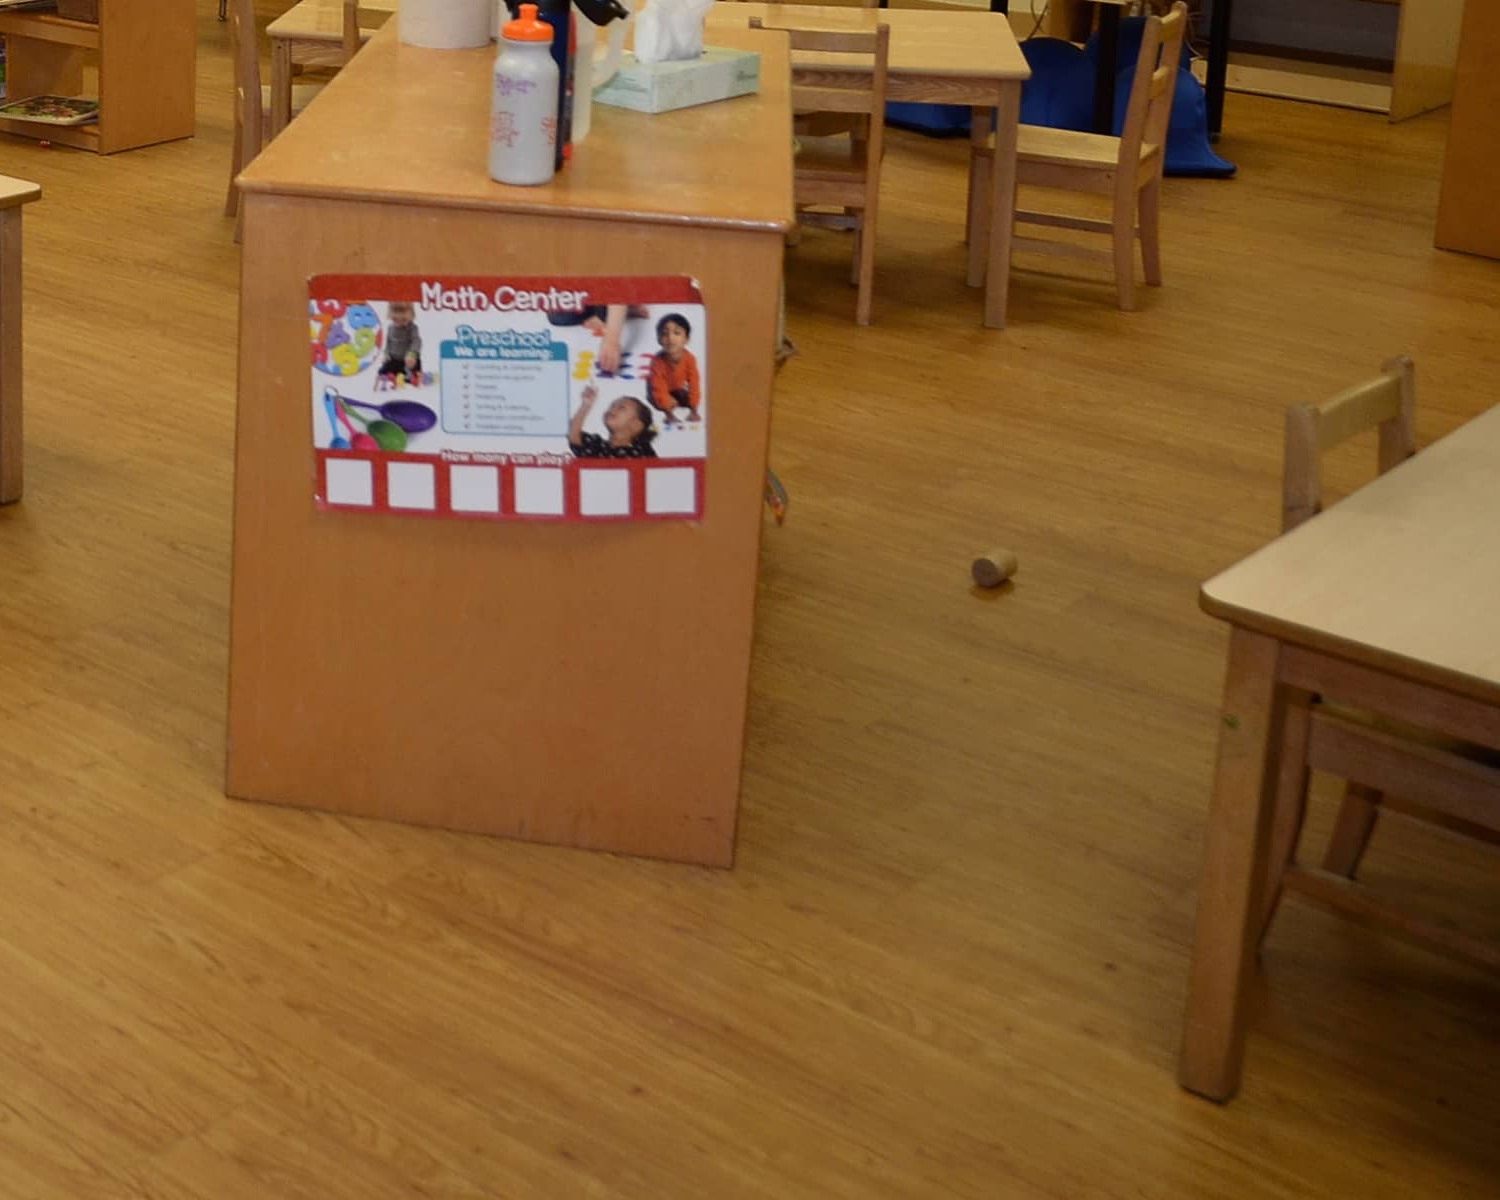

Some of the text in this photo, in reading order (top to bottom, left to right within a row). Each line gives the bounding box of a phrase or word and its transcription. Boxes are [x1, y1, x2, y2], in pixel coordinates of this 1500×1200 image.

[419, 281, 589, 312] Math Center
[455, 323, 551, 347] Preschool
[453, 346, 474, 357] We
[476, 347, 498, 358] are
[441, 449, 575, 467] How many can play?
